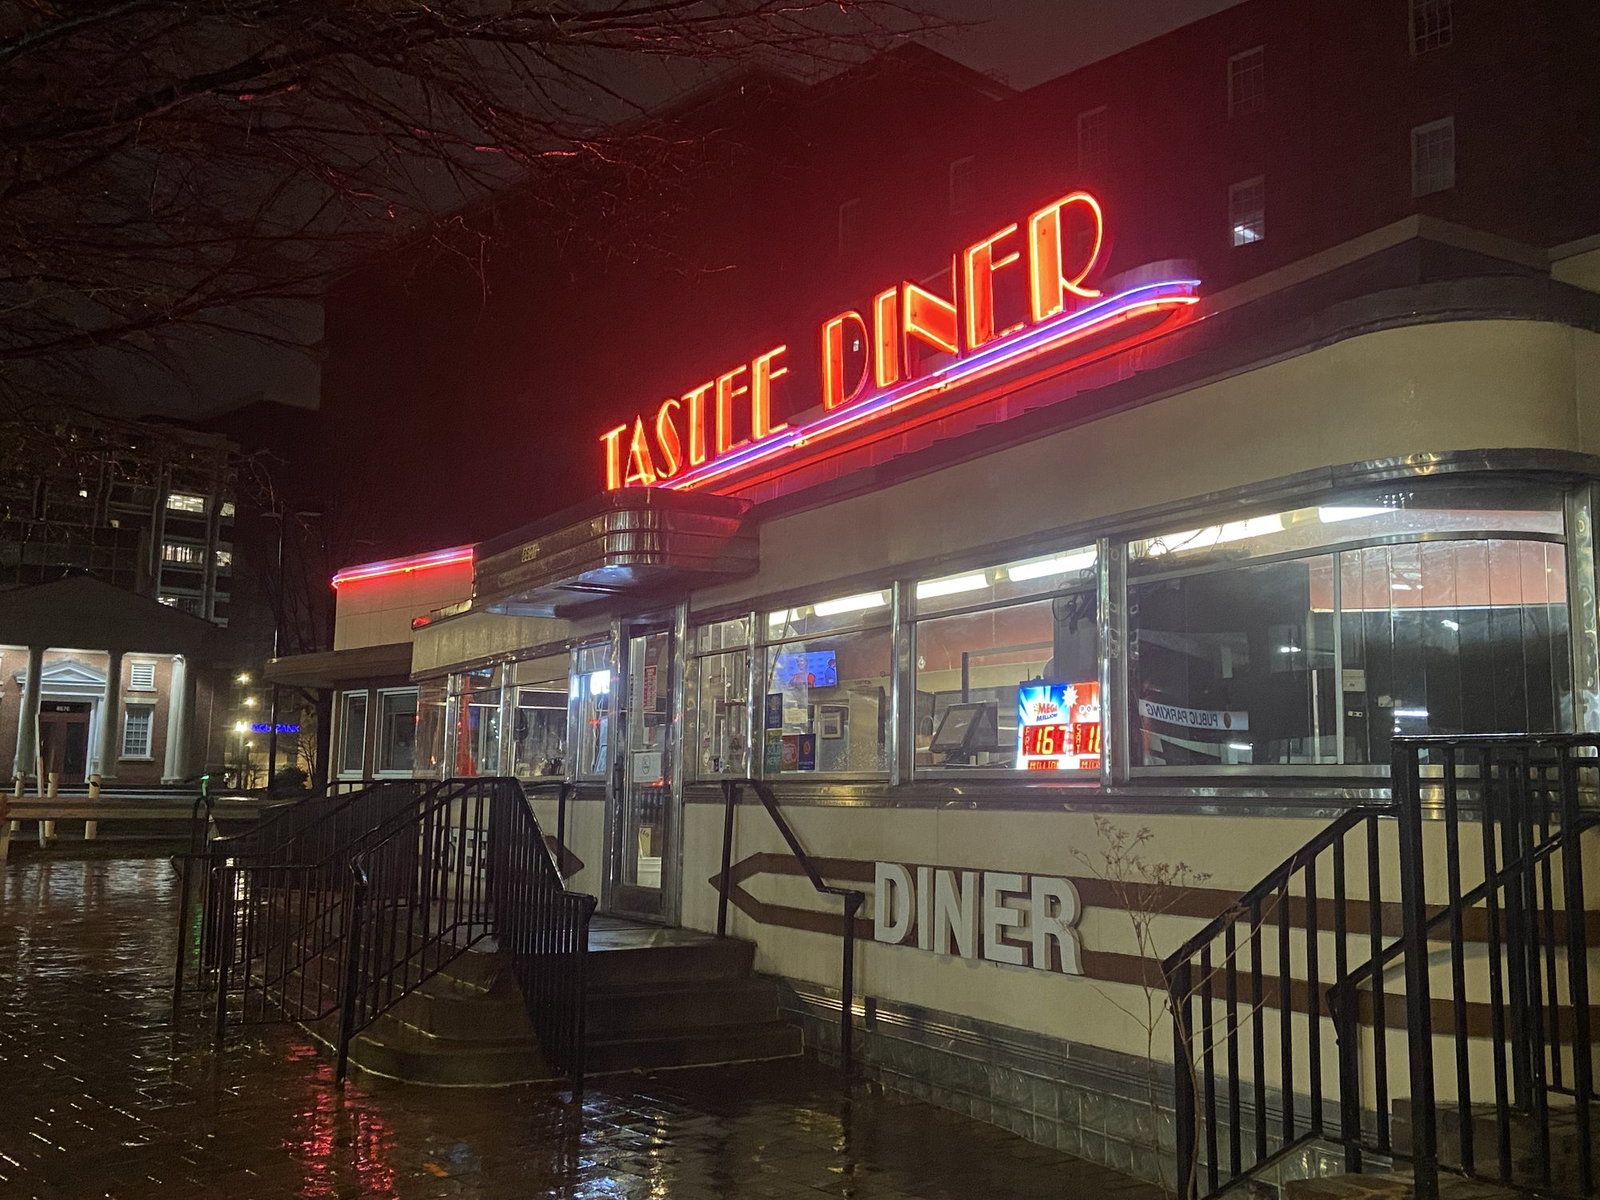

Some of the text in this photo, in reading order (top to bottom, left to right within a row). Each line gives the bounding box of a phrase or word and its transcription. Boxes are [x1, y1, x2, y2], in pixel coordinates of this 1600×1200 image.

[599, 190, 1103, 491] TASTEE DINER
[874, 861, 1084, 975] DINER
